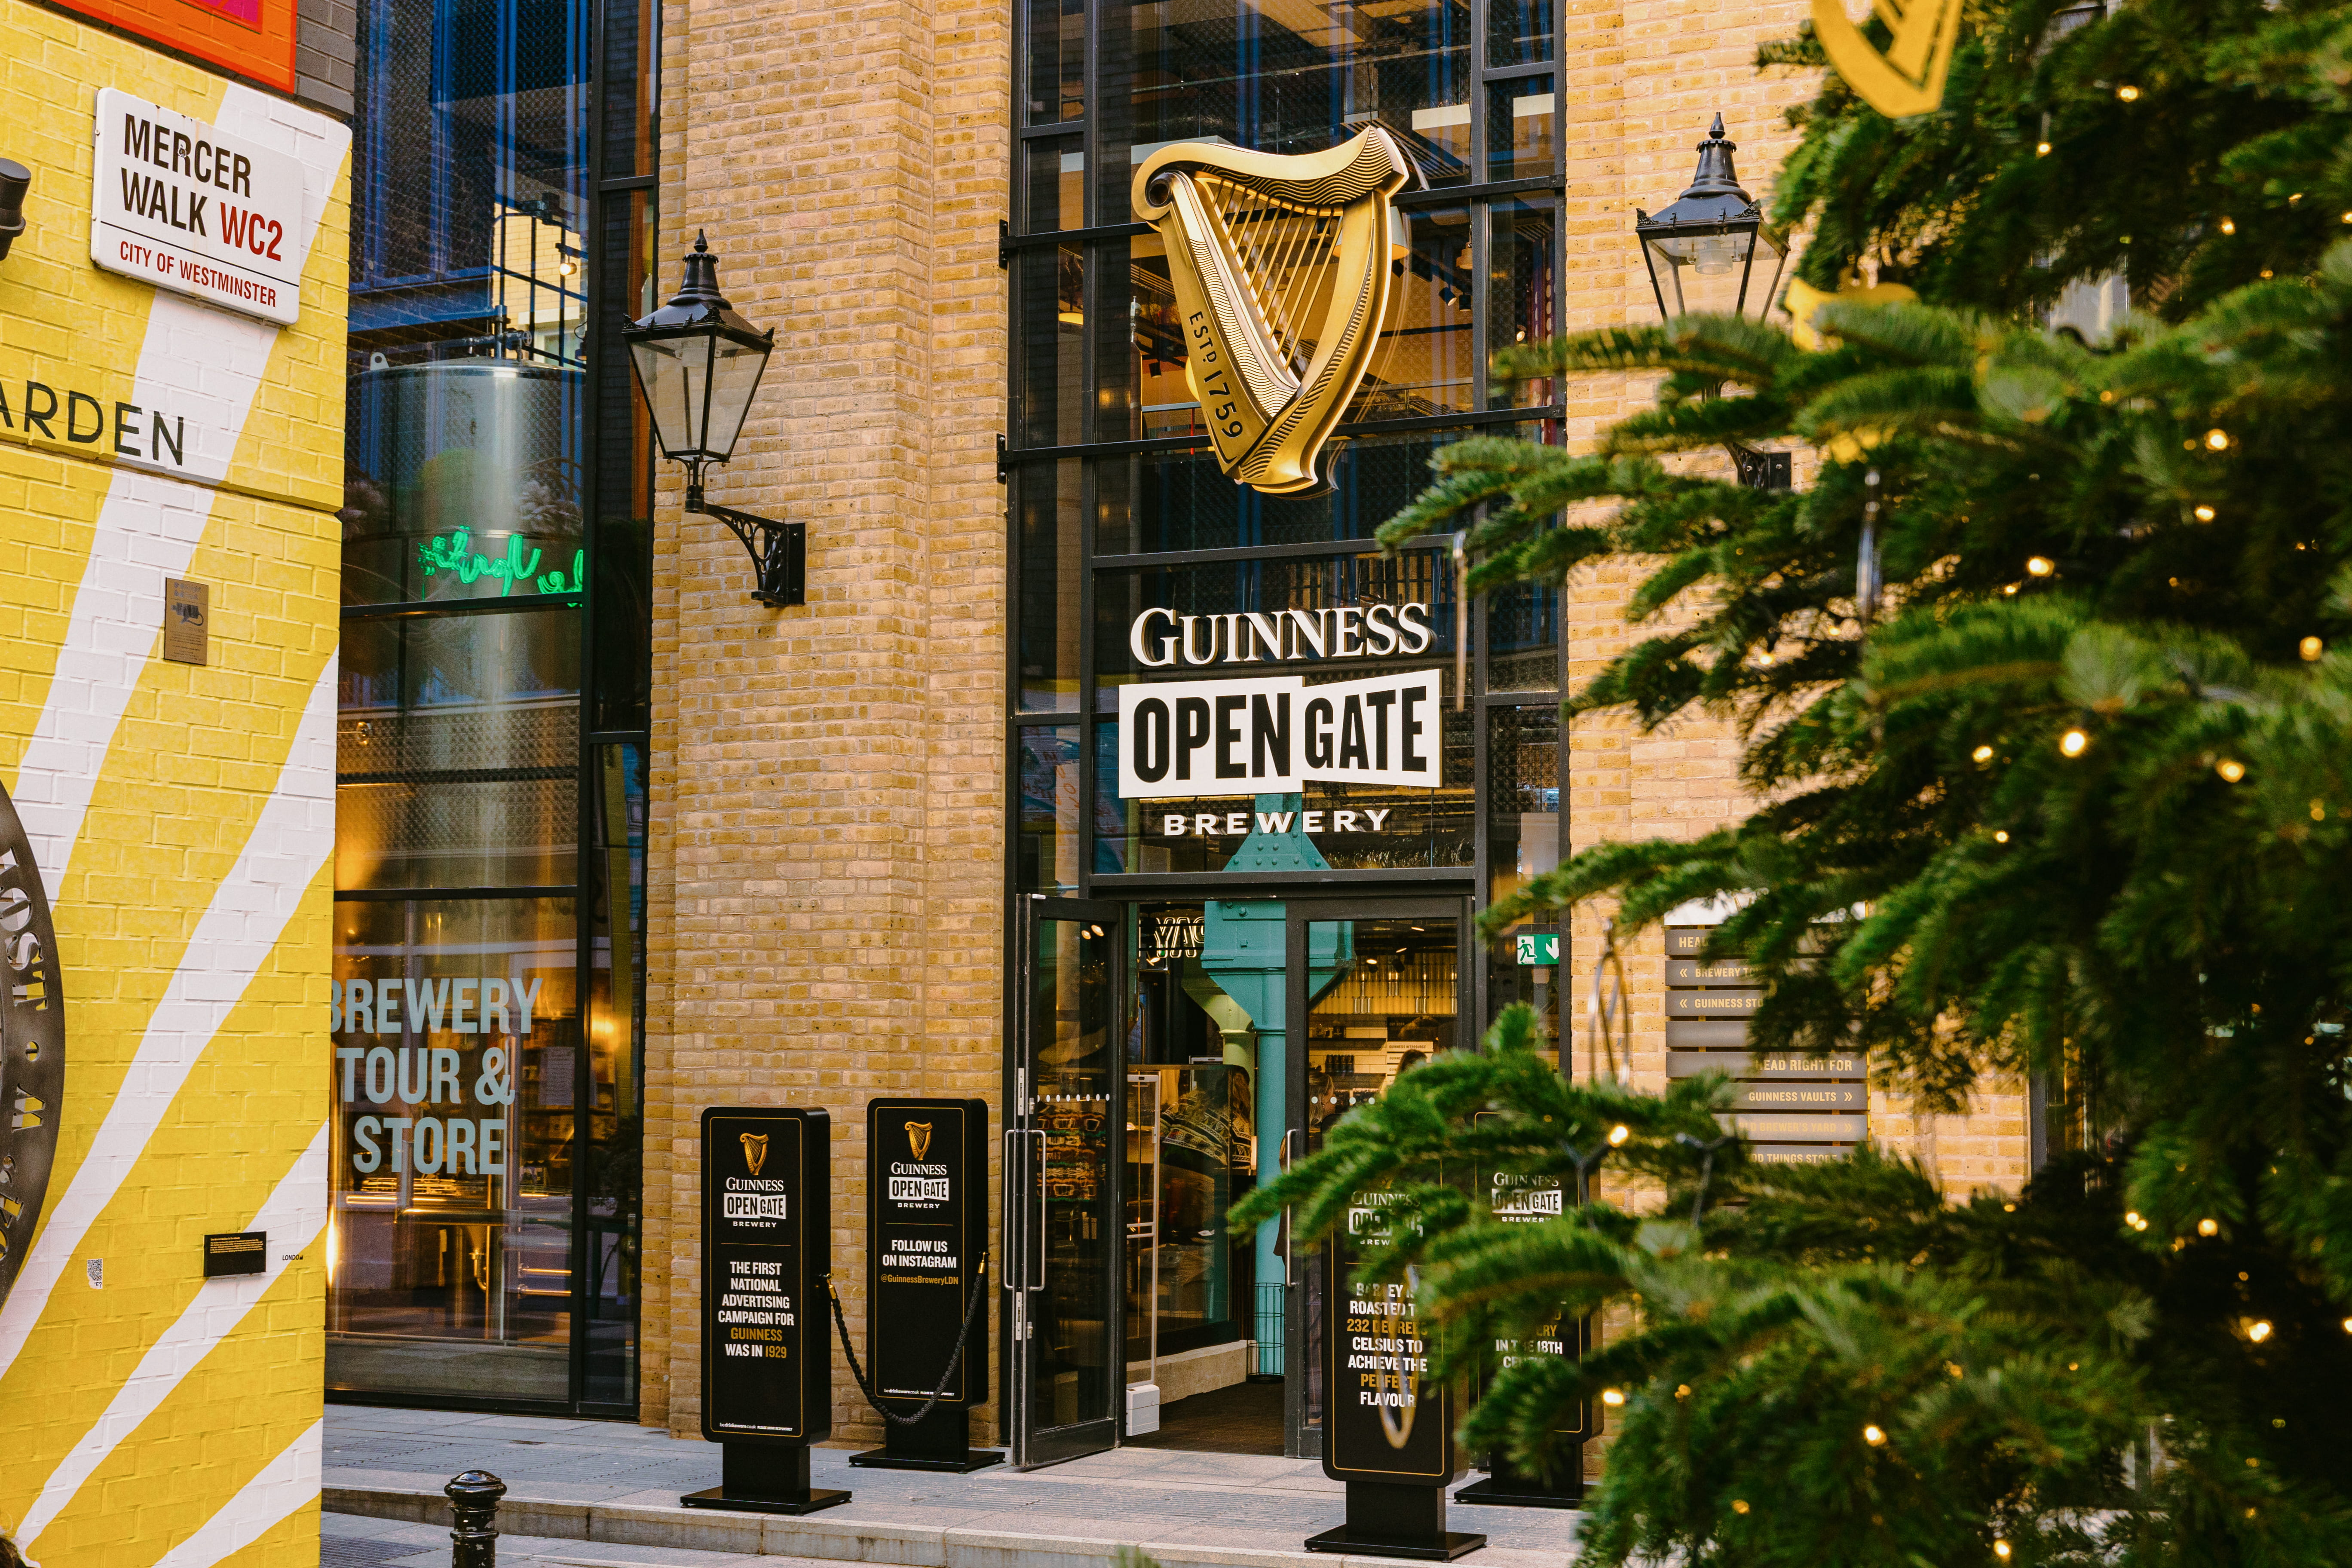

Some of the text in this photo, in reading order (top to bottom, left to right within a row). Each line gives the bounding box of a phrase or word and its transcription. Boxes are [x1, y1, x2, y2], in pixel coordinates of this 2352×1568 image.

[125, 113, 251, 198] MERCER
[121, 168, 283, 262] WALK WC2
[120, 241, 276, 307] CITY OF WESTMINSTER
[1204, 370, 1243, 438] 1759
[1130, 603, 1432, 666] GUINNESS
[1133, 686, 1427, 783] OPEN GATE
[1164, 809, 1391, 836] BREWERY
[1695, 968, 1740, 977] BREWERY
[331, 978, 543, 1033] BREWERY
[1695, 998, 1743, 1008] GUINNESS
[1790, 1060, 1826, 1071] RIGHT
[1829, 1060, 1852, 1071] FOR
[336, 1047, 515, 1105] TOUR &
[1749, 1092, 1836, 1101] GUINNESS VAULTS
[1812, 1123, 1836, 1132] YARD
[353, 1116, 506, 1175] STORE
[1767, 1154, 1803, 1163] THINGS
[891, 1162, 947, 1175] GUINNESS
[726, 1177, 784, 1191] GUINNESS
[892, 1180, 946, 1197] OPEN GATE
[727, 1197, 784, 1216] OPEN GATE
[1533, 1194, 1559, 1211] GATE
[892, 1240, 948, 1253] FOLLOW US
[730, 1262, 782, 1275] THE FIRST
[882, 1255, 956, 1268] ON INSTAGRAM
[731, 1278, 781, 1292] NATIONAL
[881, 1274, 959, 1285] @GuinnessBreweryLDN
[722, 1294, 790, 1309] ADVERTISING
[1350, 1301, 1406, 1315] ROASTED
[718, 1311, 794, 1326] CAMPAIGN FOR
[1347, 1319, 1369, 1332] 232
[731, 1327, 782, 1341] GUINNESS
[725, 1344, 787, 1358] WAS IN 1929
[1352, 1337, 1423, 1353] CELSIUS TO
[1496, 1339, 1508, 1351] IN
[1537, 1341, 1563, 1354] 18TH
[1348, 1355, 1427, 1372] ACHIEVE THE
[1360, 1392, 1416, 1408] FLAVOUR
